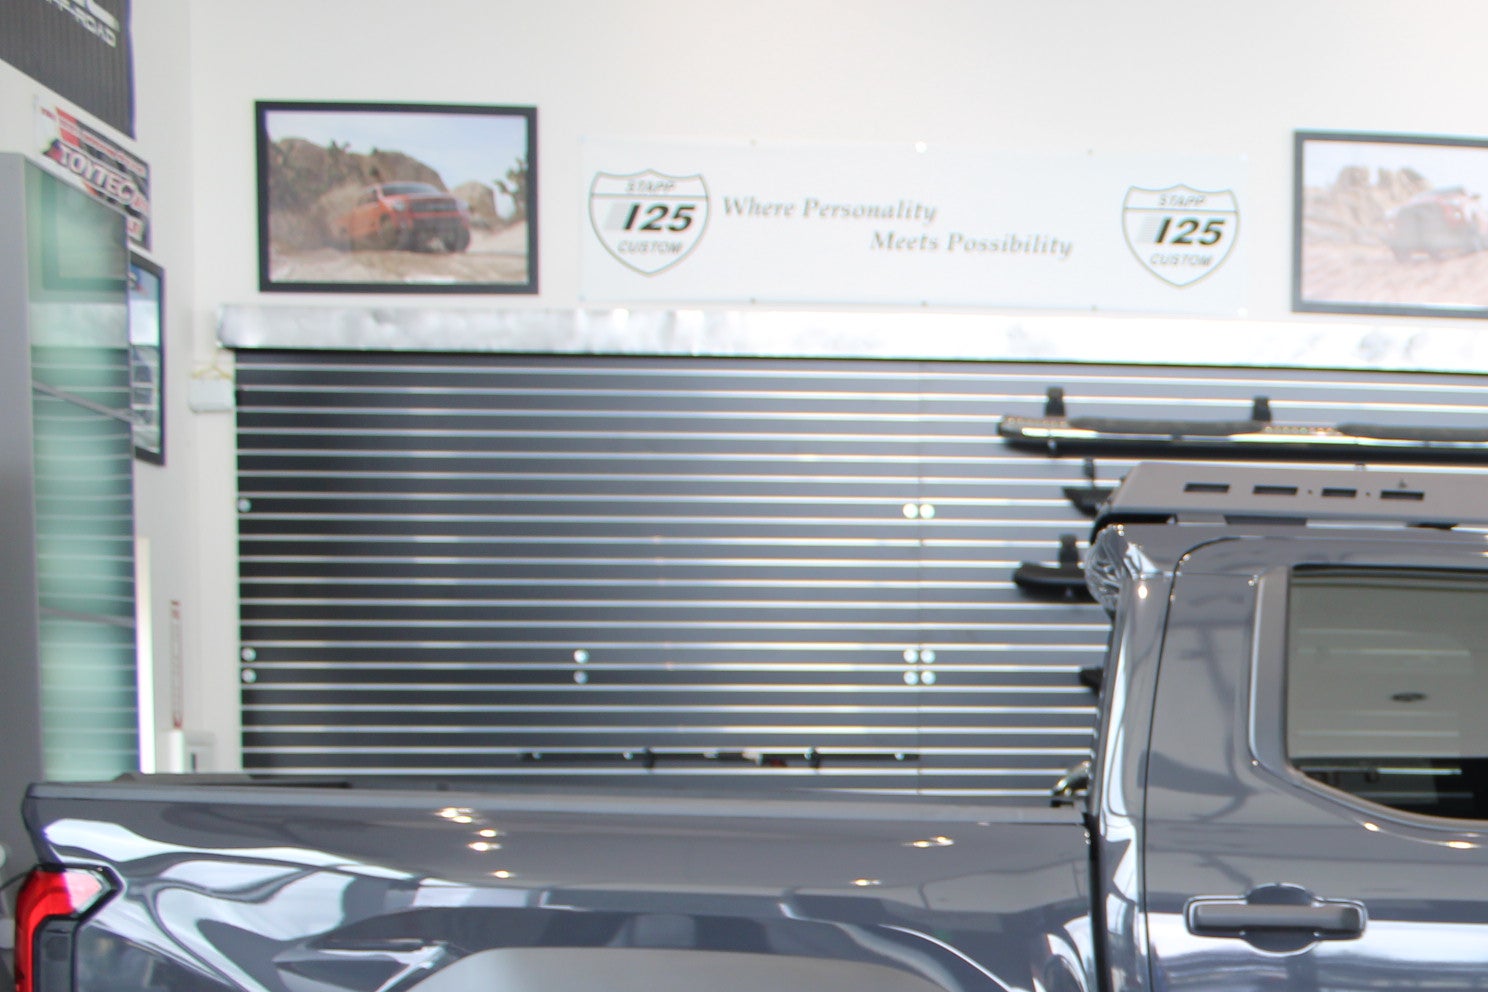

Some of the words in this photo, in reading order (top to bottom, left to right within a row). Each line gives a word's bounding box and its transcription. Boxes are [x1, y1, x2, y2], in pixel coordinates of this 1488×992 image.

[626, 179, 675, 193] STAPP
[722, 194, 797, 218] Where
[802, 197, 938, 225] Personality
[1158, 193, 1207, 207] STAPP
[622, 201, 698, 232] 125
[1154, 215, 1226, 246] 125
[617, 239, 683, 254] CUSTOM
[870, 230, 939, 252] Meets
[946, 232, 1073, 260] Possibility
[1150, 252, 1214, 266] CUSTOM
